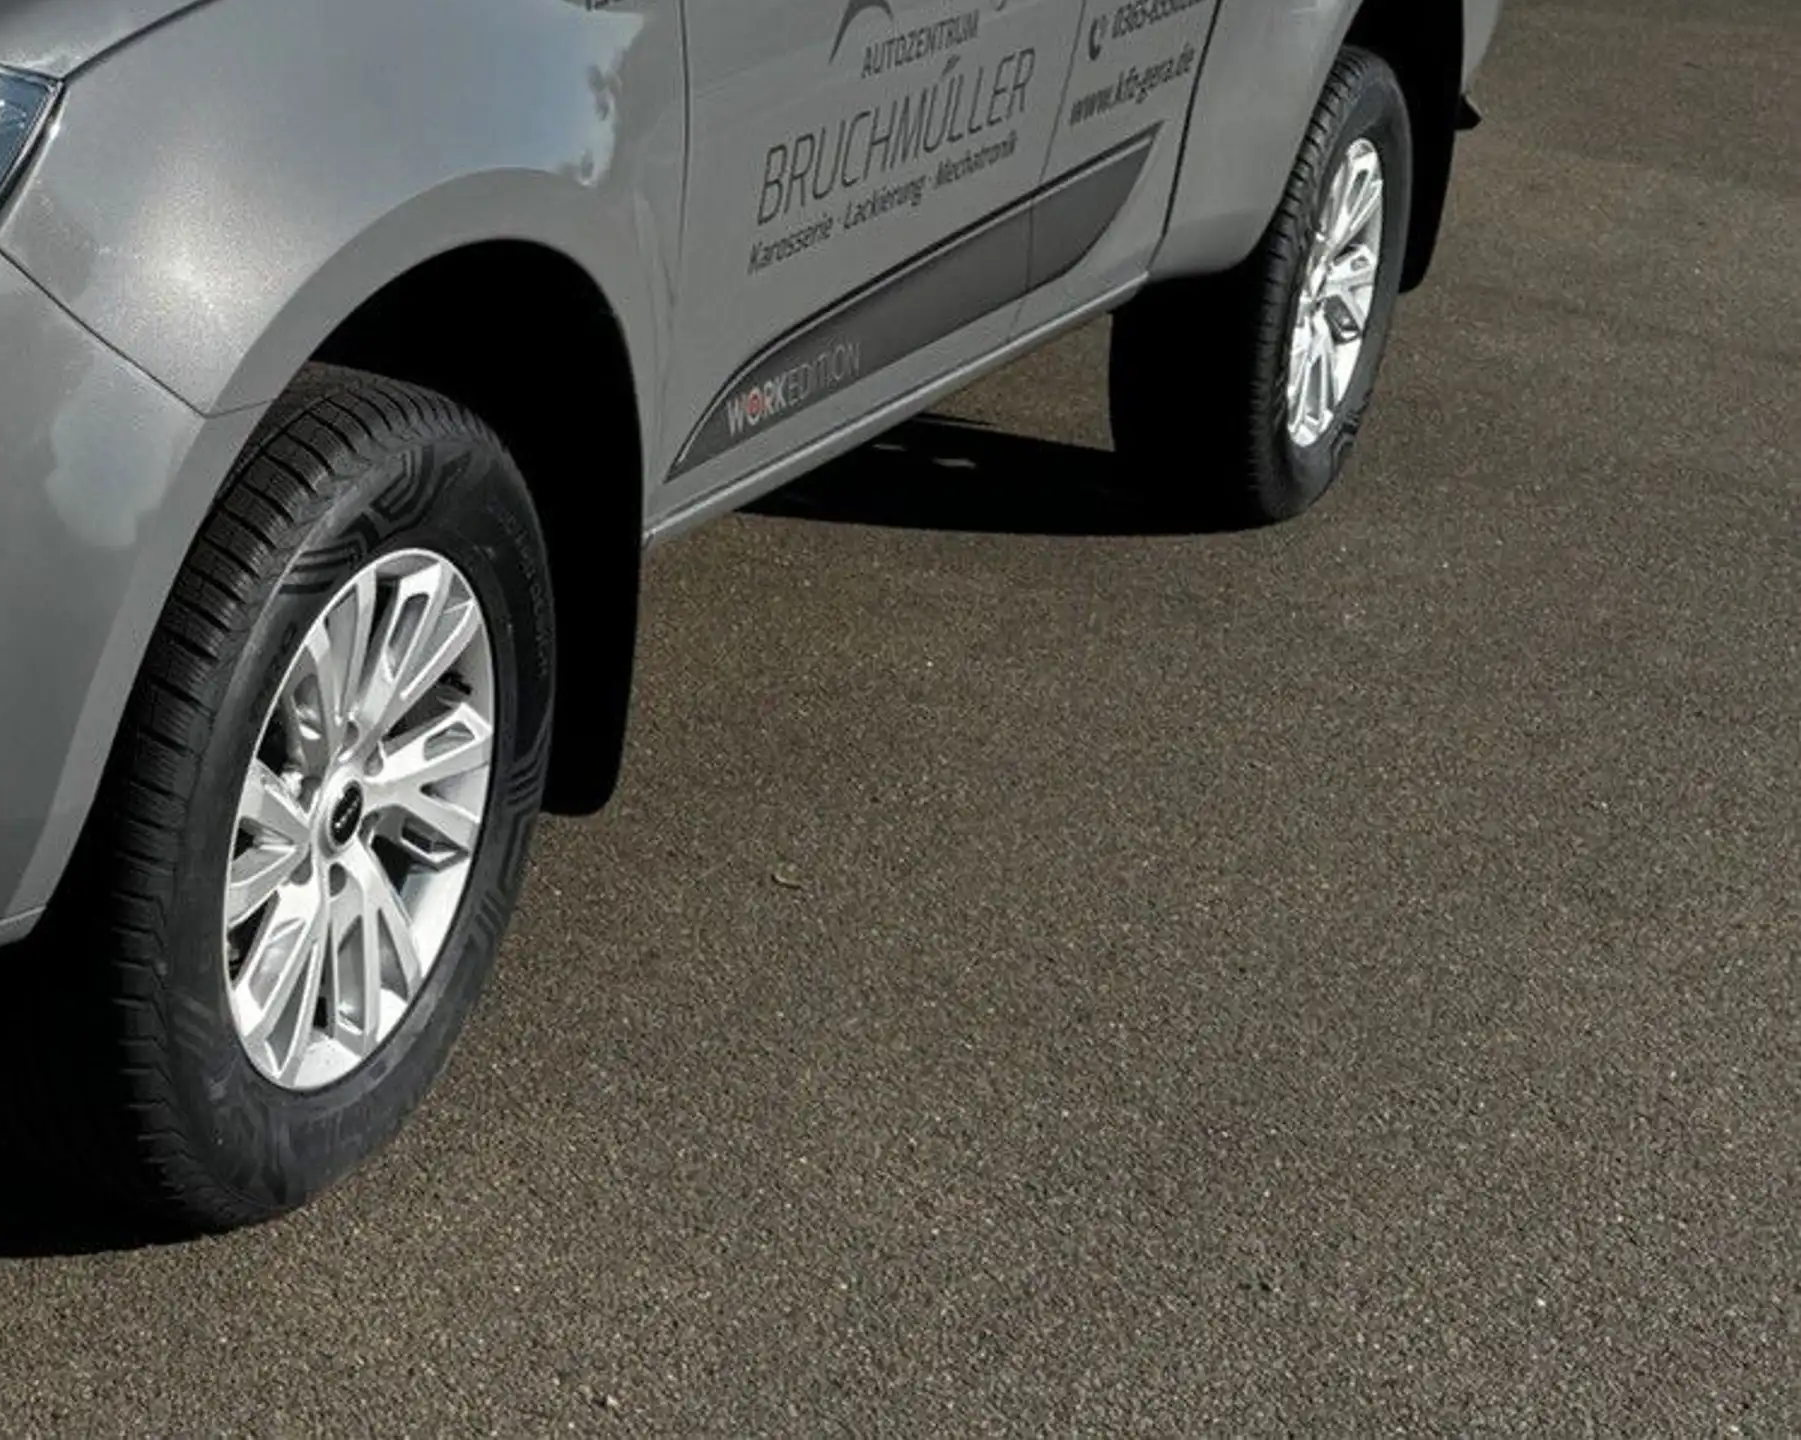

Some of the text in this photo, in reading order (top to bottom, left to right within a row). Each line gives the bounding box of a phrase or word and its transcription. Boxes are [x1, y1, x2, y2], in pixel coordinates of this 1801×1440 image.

[860, 9, 979, 78] AUTOZENTRUM
[757, 46, 1036, 226] BRUCHMÜLLER
[747, 212, 834, 275] Karosserie
